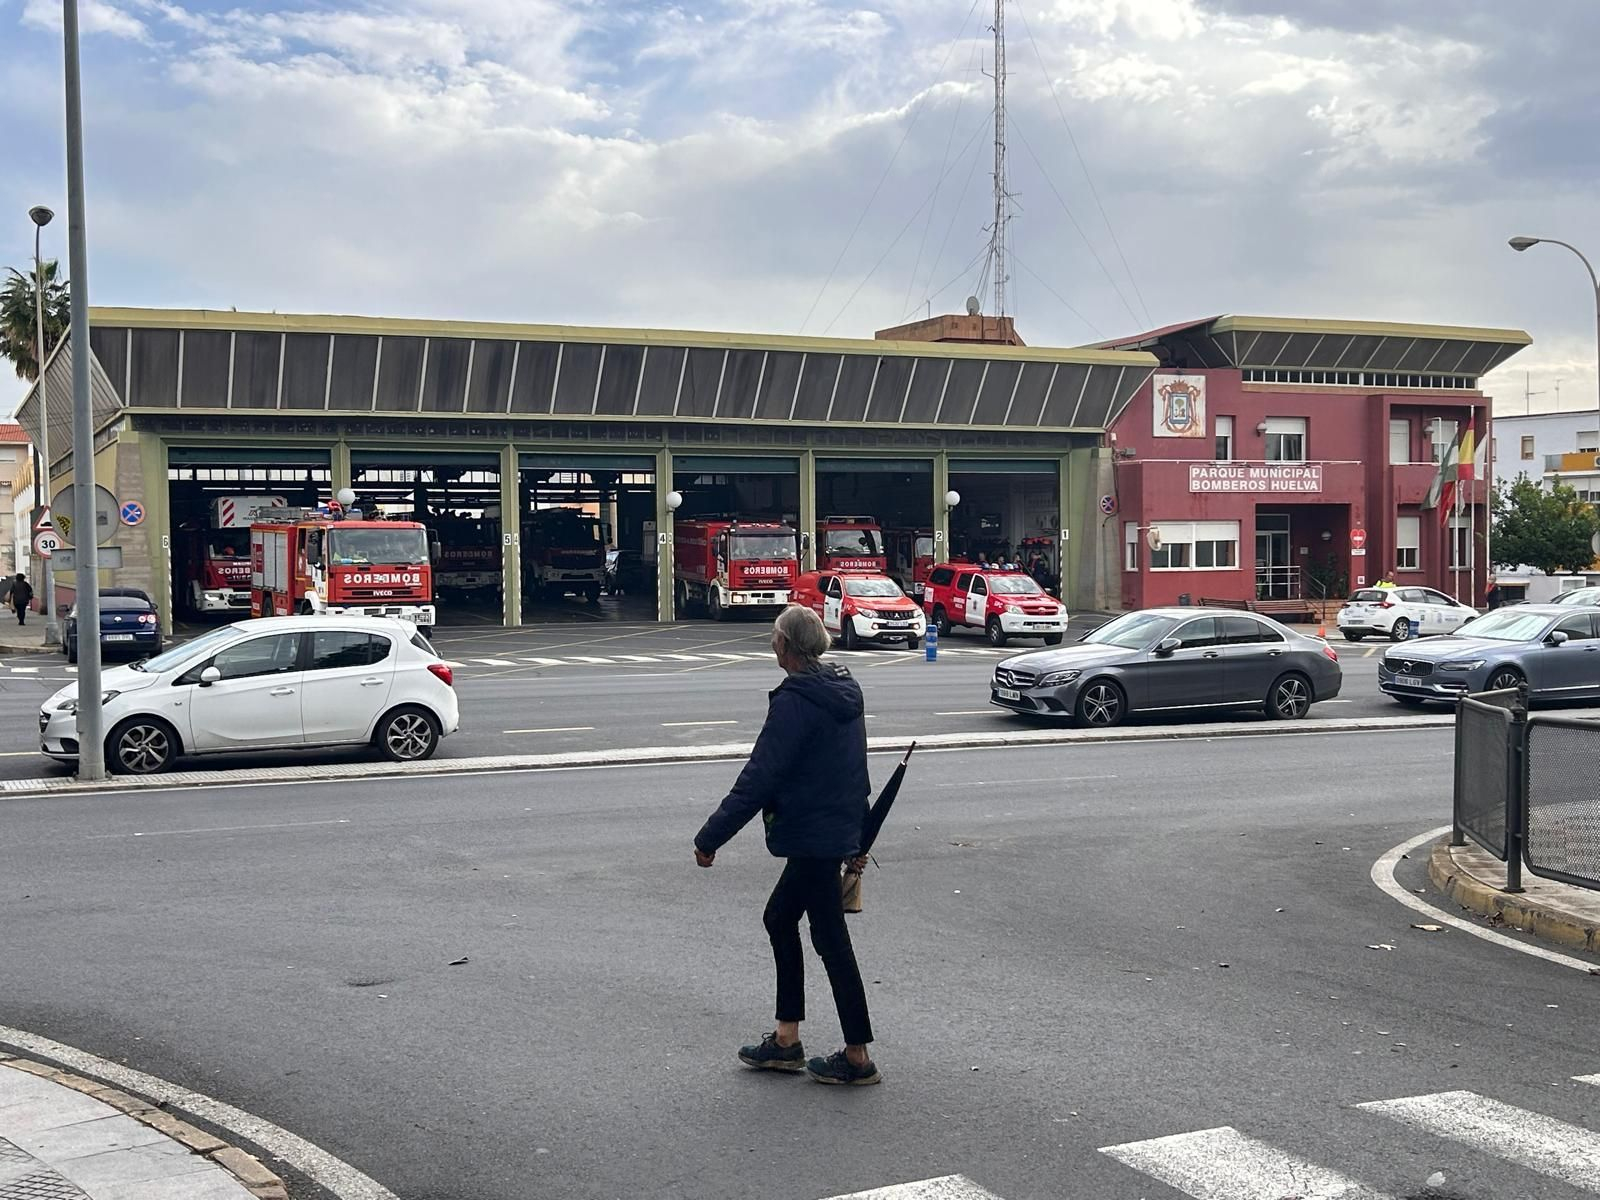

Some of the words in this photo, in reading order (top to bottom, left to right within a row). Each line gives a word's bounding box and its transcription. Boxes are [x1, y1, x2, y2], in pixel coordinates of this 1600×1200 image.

[1192, 467, 1245, 478] PARQUE
[1249, 467, 1319, 478] MUNICIPAL
[1192, 480, 1266, 490] BOMBEROS
[1271, 480, 1318, 490] HUELVA
[41, 540, 56, 549] 30
[163, 536, 169, 546] 6
[505, 535, 511, 544] 5
